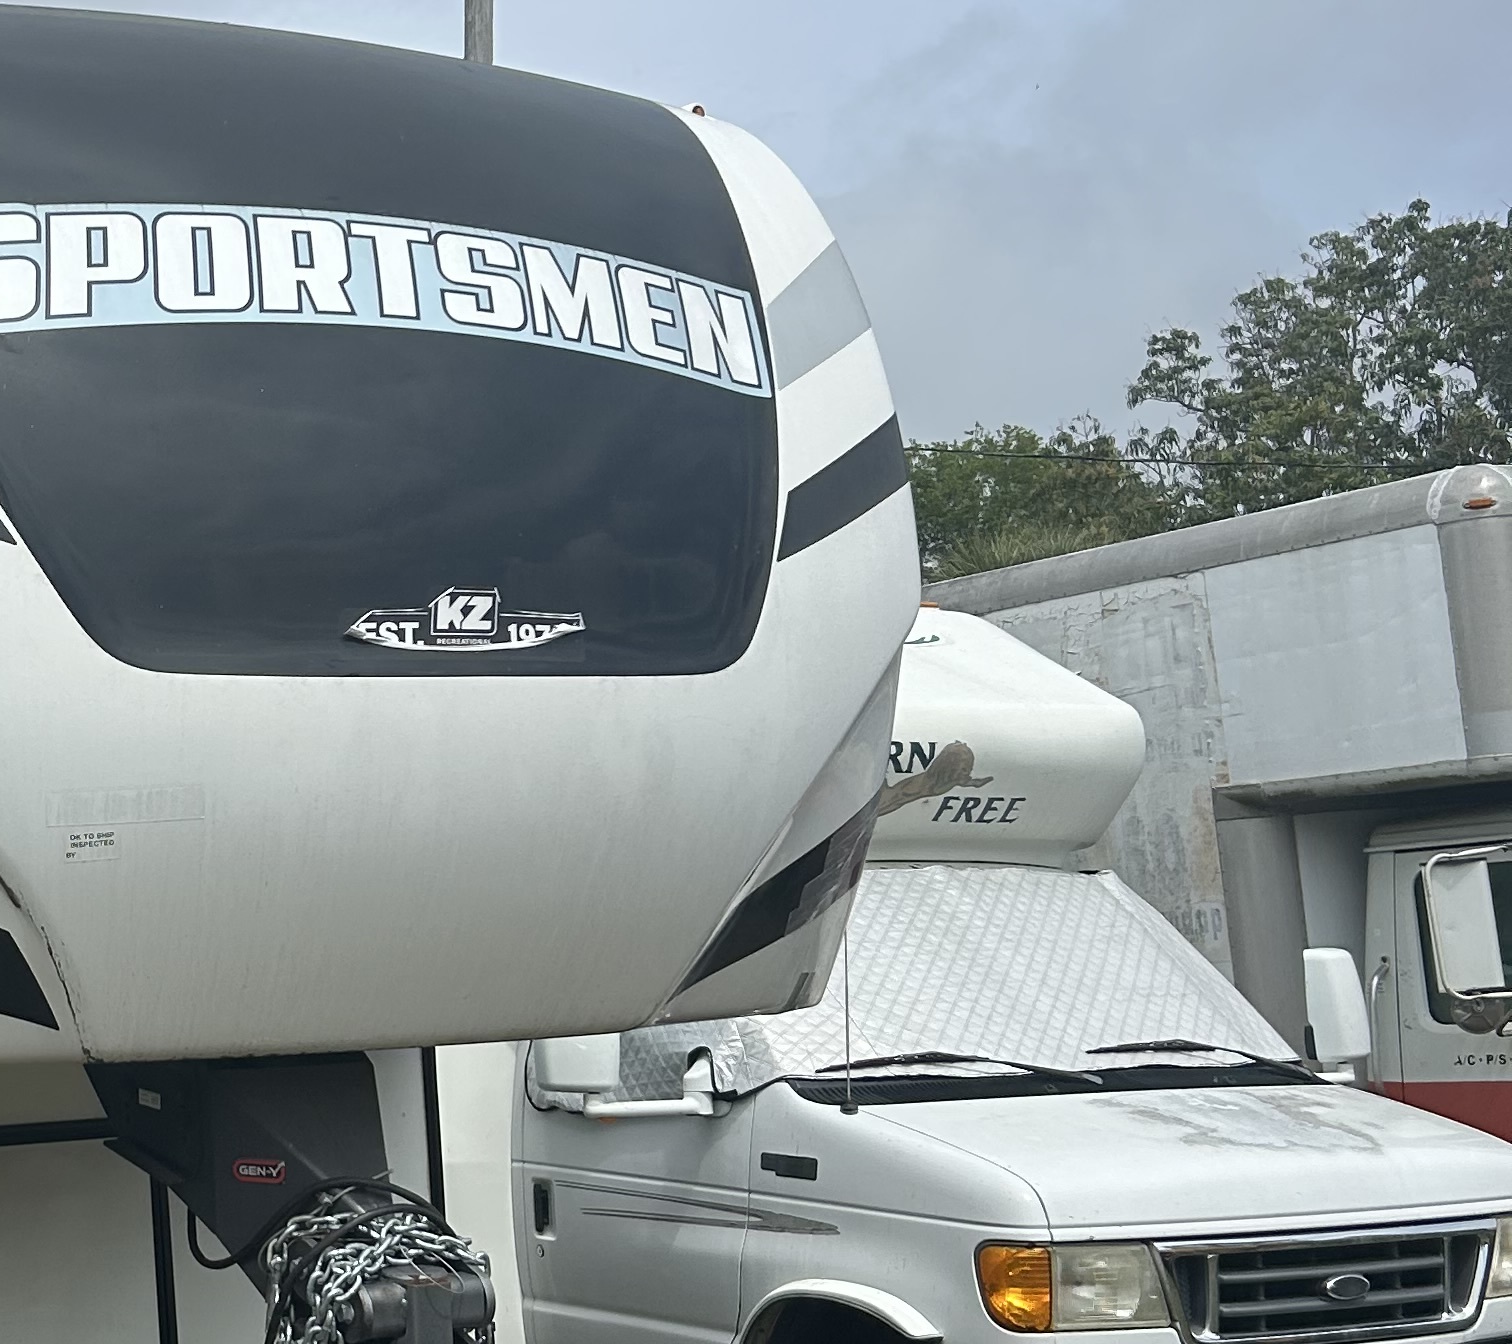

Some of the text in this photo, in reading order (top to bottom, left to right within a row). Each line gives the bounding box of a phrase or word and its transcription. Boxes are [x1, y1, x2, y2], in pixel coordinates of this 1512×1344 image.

[437, 595, 494, 630] KZ
[932, 796, 1026, 823] FREE
[1454, 1054, 1507, 1066] A/C P/S
[239, 1161, 285, 1177] GEN-Y
